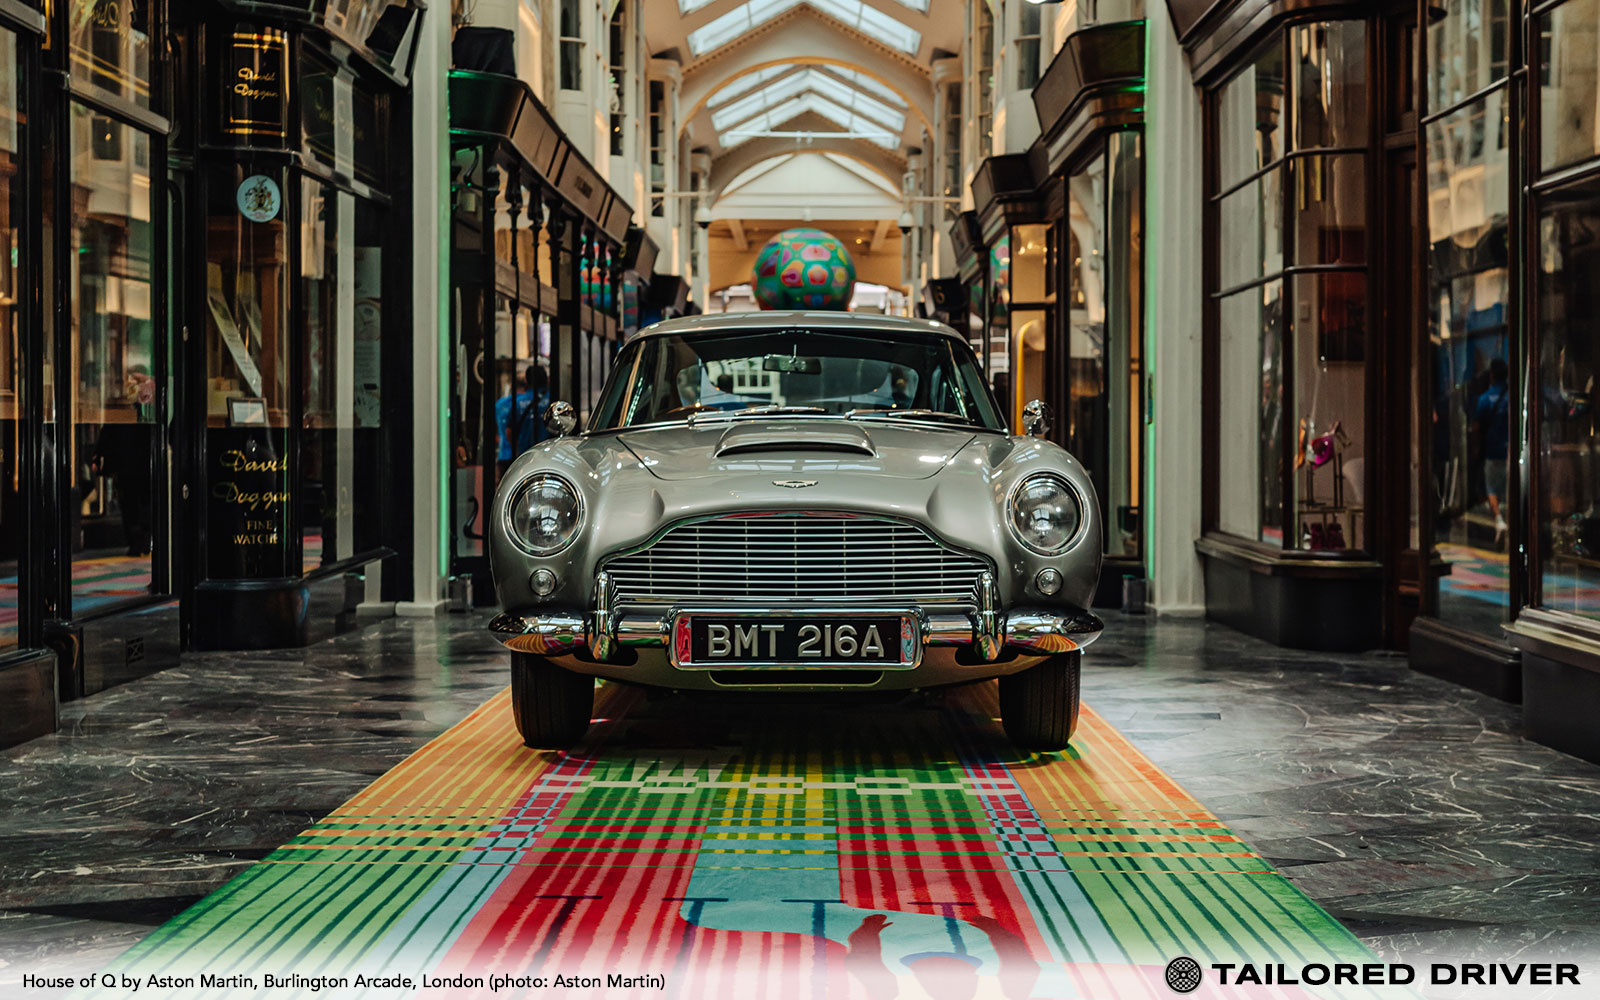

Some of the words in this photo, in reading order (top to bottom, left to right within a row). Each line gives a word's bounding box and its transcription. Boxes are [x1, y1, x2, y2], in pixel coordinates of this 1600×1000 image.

[220, 450, 287, 472] David
[213, 481, 291, 511] Duggan
[247, 520, 273, 531] FINE
[708, 624, 785, 657] BMT
[797, 624, 885, 657] 216A
